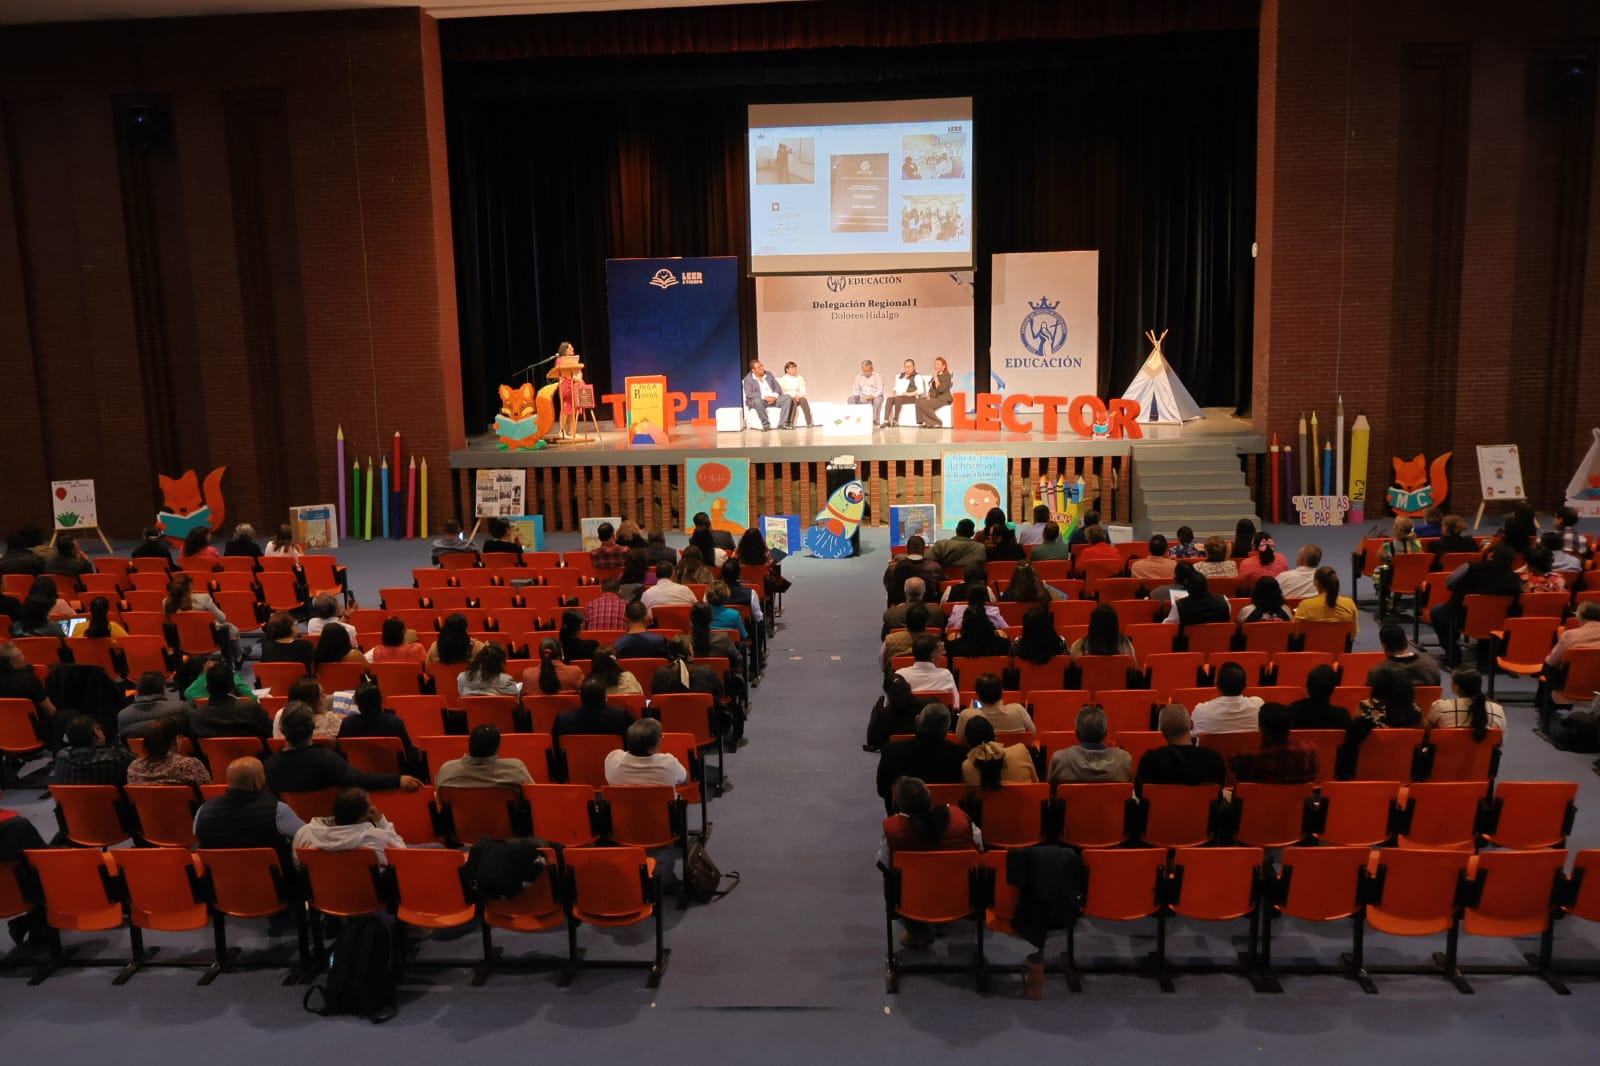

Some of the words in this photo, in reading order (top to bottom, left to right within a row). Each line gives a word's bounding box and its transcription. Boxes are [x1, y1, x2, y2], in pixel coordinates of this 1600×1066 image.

[682, 272, 703, 280] LEER
[848, 274, 902, 285] EDUCACIÓN
[812, 300, 866, 310] Delegación
[868, 298, 911, 309] Regional
[913, 298, 917, 306] I
[831, 311, 865, 320] Dolores
[866, 310, 900, 320] Hidalgo
[1005, 355, 1082, 368] EDUCACIÓN
[601, 391, 717, 429] TPI
[952, 392, 1144, 439] LECTOR
